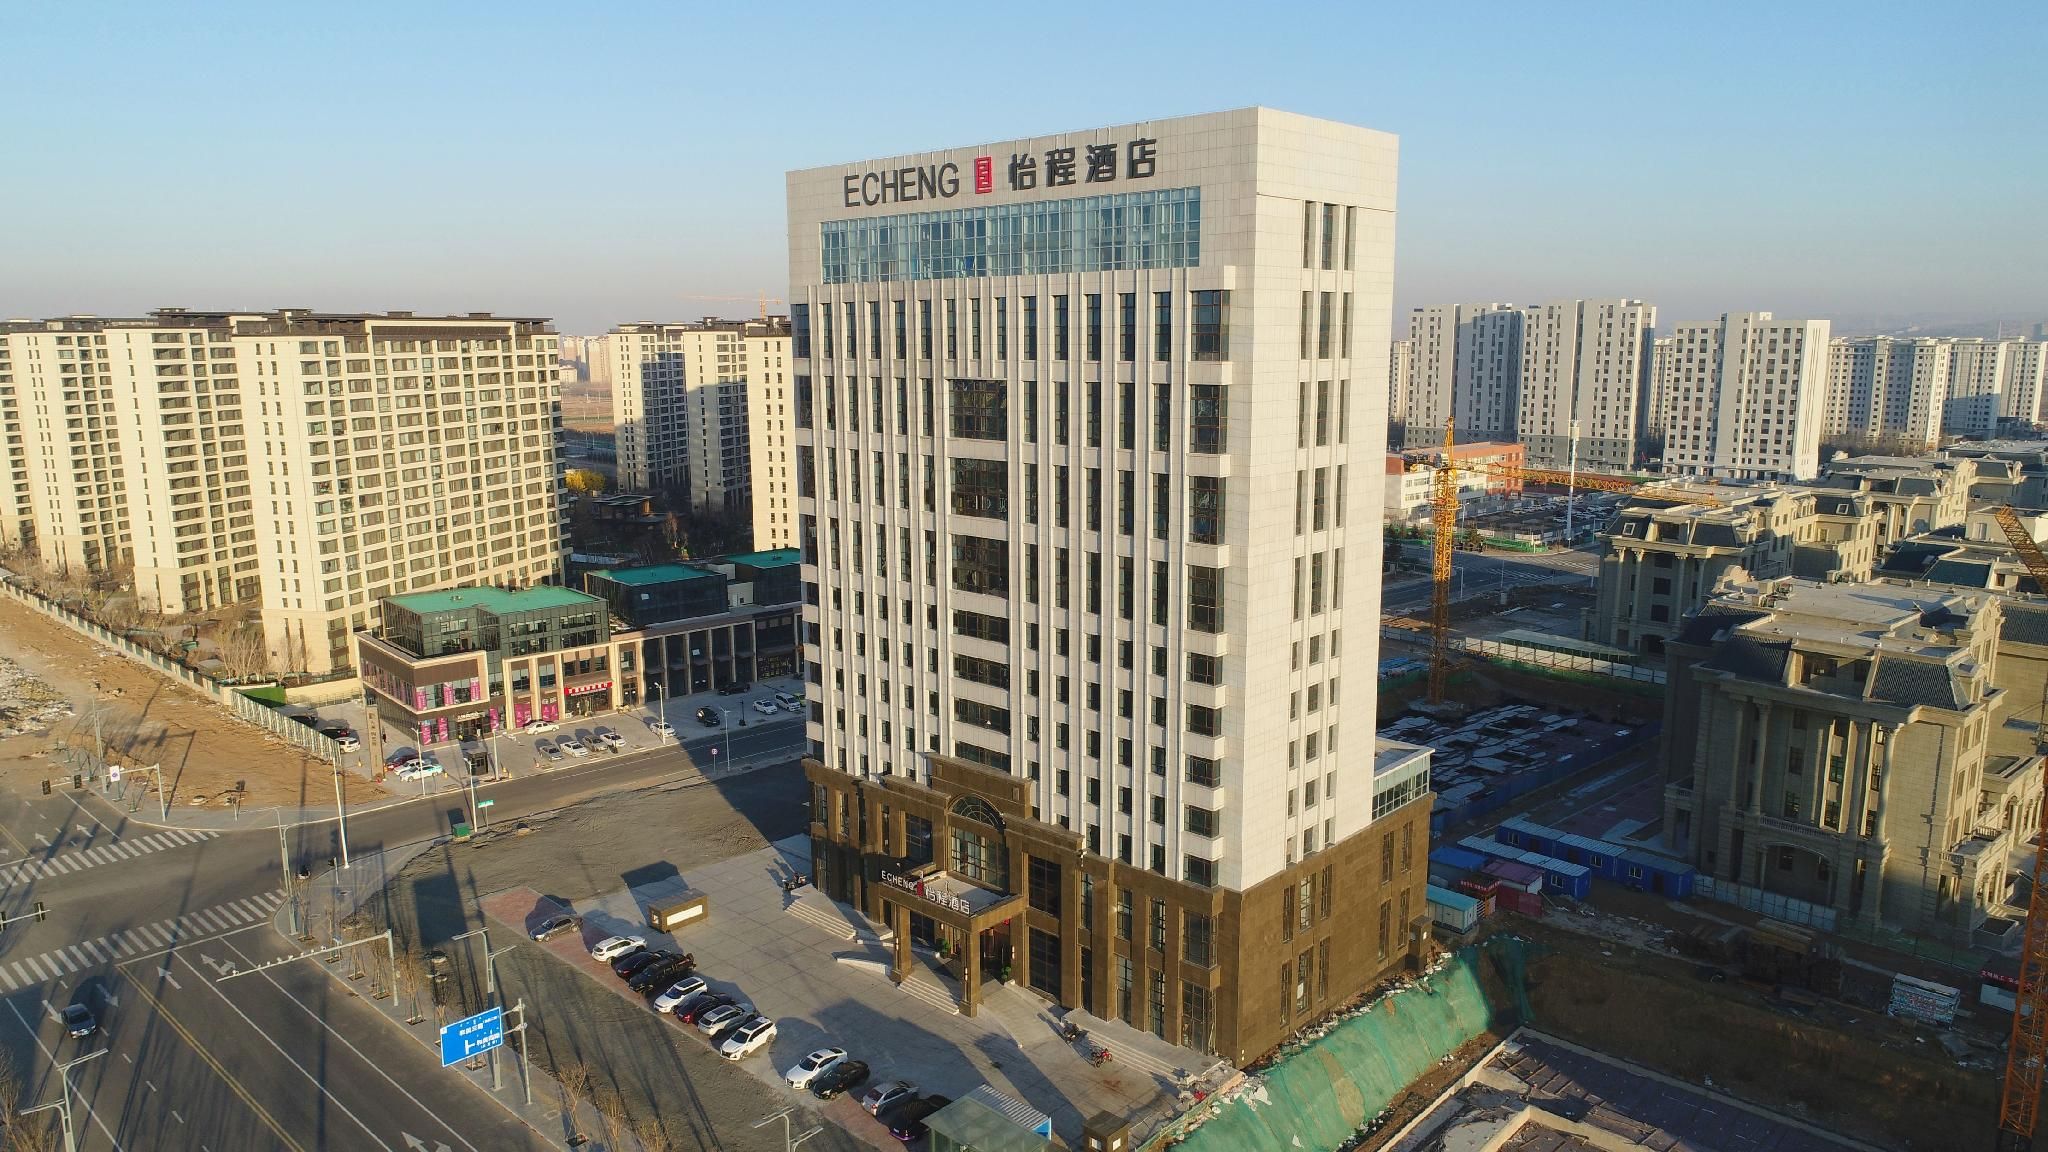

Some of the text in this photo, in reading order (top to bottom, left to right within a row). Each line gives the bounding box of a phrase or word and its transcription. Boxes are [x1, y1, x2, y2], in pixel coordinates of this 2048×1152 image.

[1009, 138, 1157, 191] 怡程酒店
[843, 162, 960, 208] ECHENG
[882, 871, 914, 889] ECHENG
[926, 887, 969, 914] 怡程酒店
